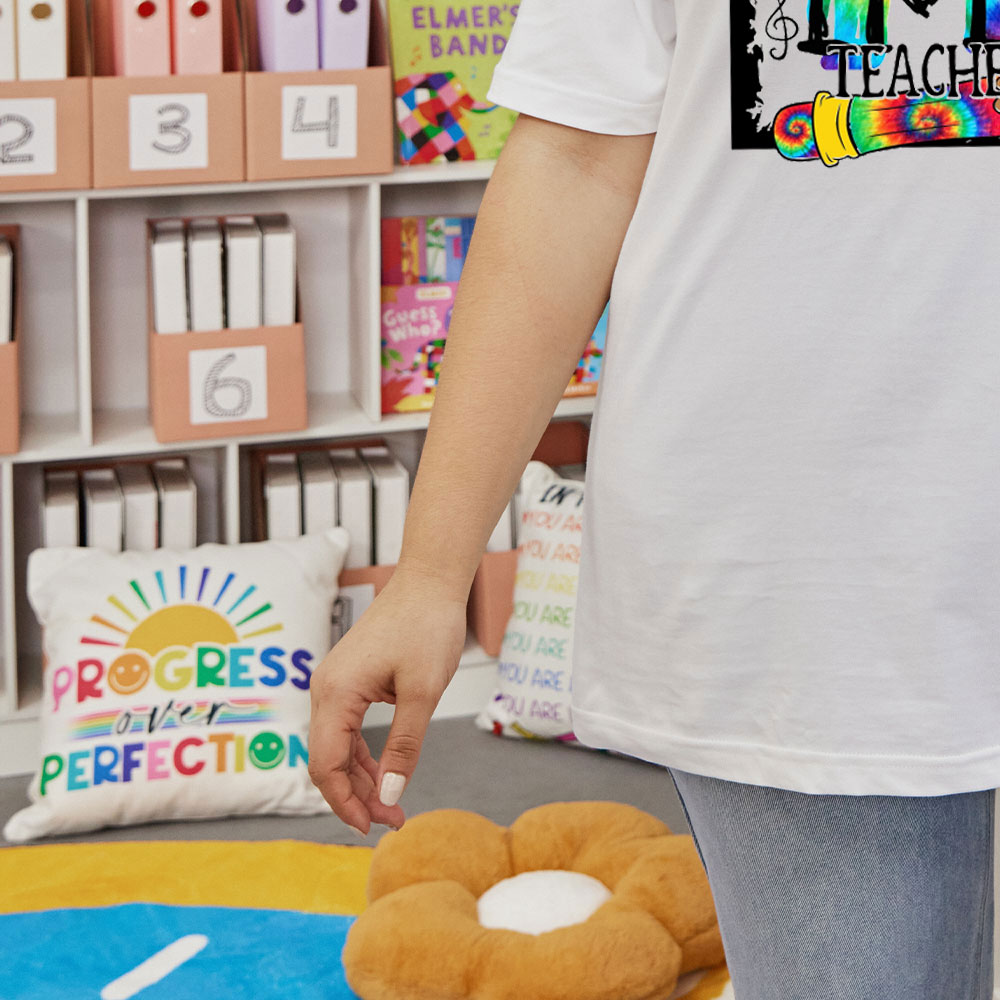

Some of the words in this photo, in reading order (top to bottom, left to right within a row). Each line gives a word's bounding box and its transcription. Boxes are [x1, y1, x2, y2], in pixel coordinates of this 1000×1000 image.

[429, 34, 508, 59] BAND
[151, 103, 192, 155] 3
[291, 95, 340, 148] 4
[0, 113, 34, 163] 2
[383, 305, 437, 327] Guess
[390, 319, 443, 343] Who?
[203, 352, 252, 418] 6
[539, 604, 573, 628] ARE
[534, 635, 568, 660] ARE
[52, 646, 314, 713] PROGRESS
[530, 666, 565, 692] ARE
[115, 699, 232, 735] over
[529, 697, 562, 721] ARE
[40, 732, 310, 796] PERFECTION
